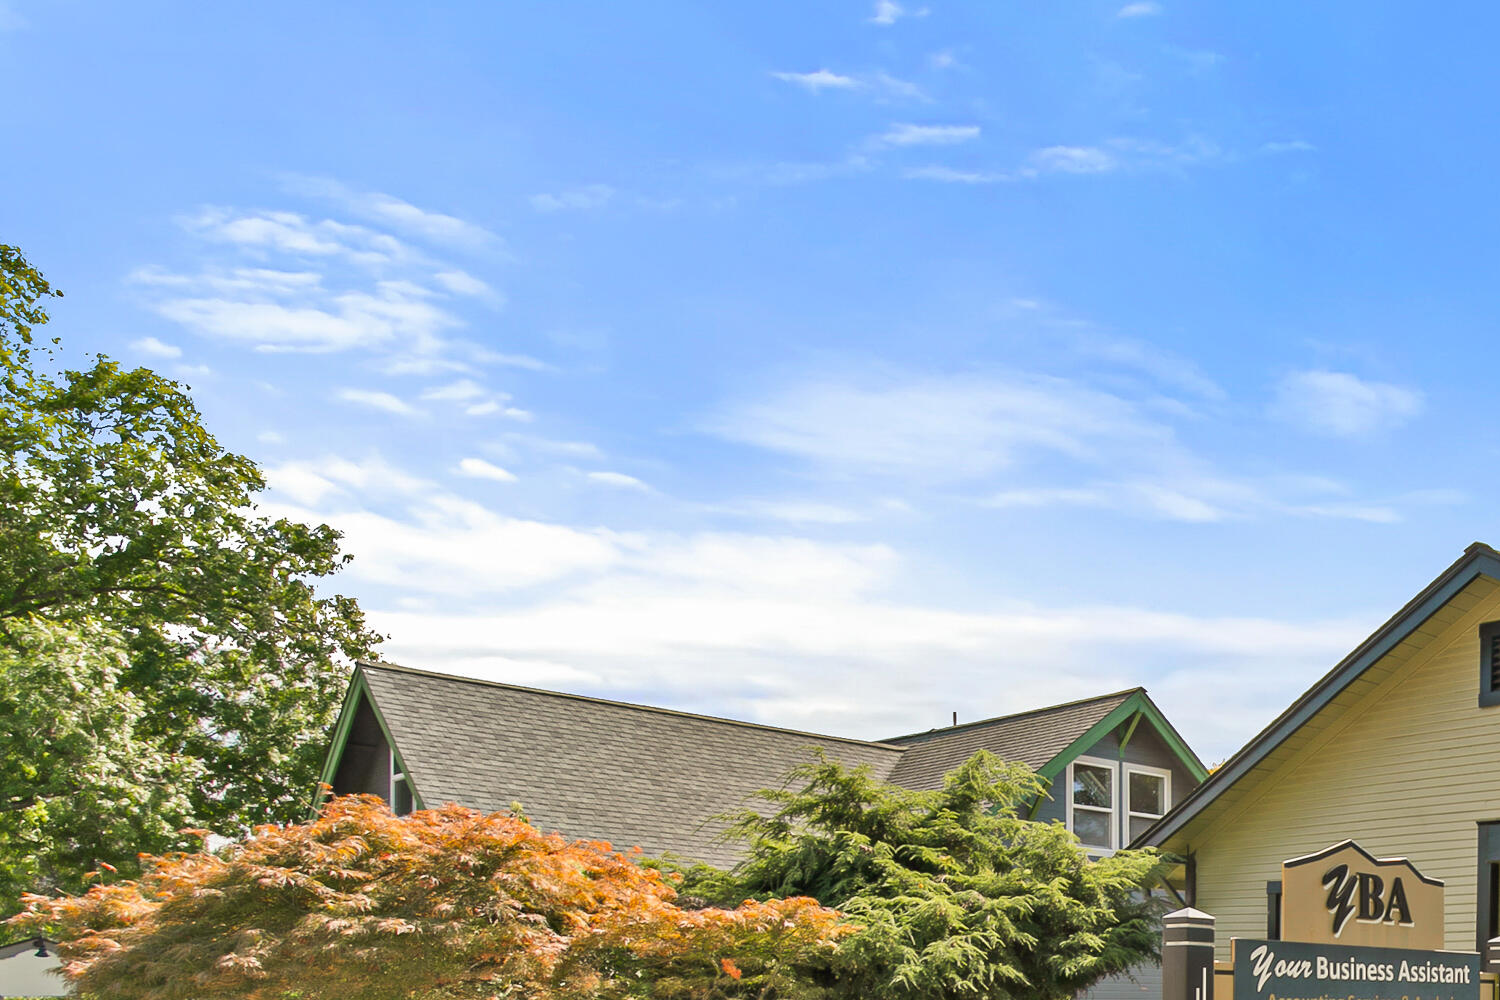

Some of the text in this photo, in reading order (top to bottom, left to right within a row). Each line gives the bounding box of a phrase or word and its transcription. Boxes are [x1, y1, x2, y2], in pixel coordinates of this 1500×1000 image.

[1321, 863, 1415, 938] YBA
[1249, 944, 1471, 993] Your Business Assistant
